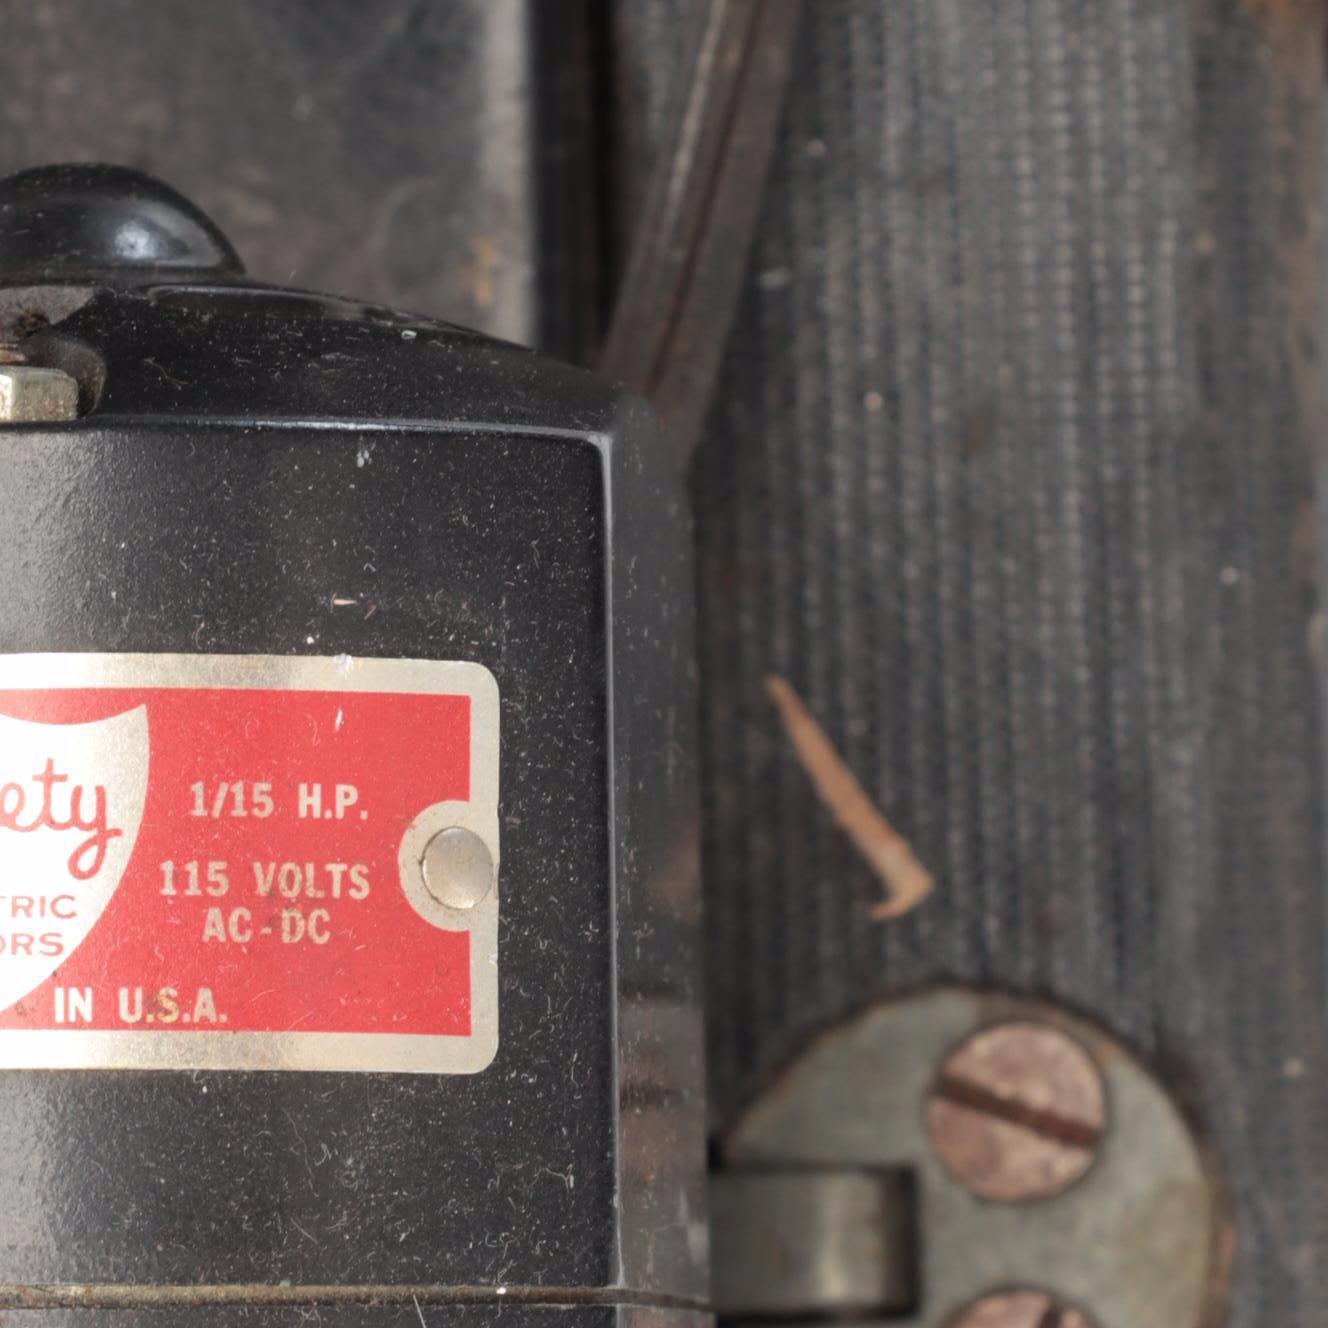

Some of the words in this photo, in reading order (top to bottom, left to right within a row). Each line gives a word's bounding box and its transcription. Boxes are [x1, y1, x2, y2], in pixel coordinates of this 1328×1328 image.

[190, 782, 274, 819] 1/15
[298, 783, 369, 820] H.P.
[160, 860, 229, 897] 115
[254, 862, 370, 900] VOLTS
[54, 987, 93, 1023] IN
[119, 987, 228, 1024] U.S.A.
